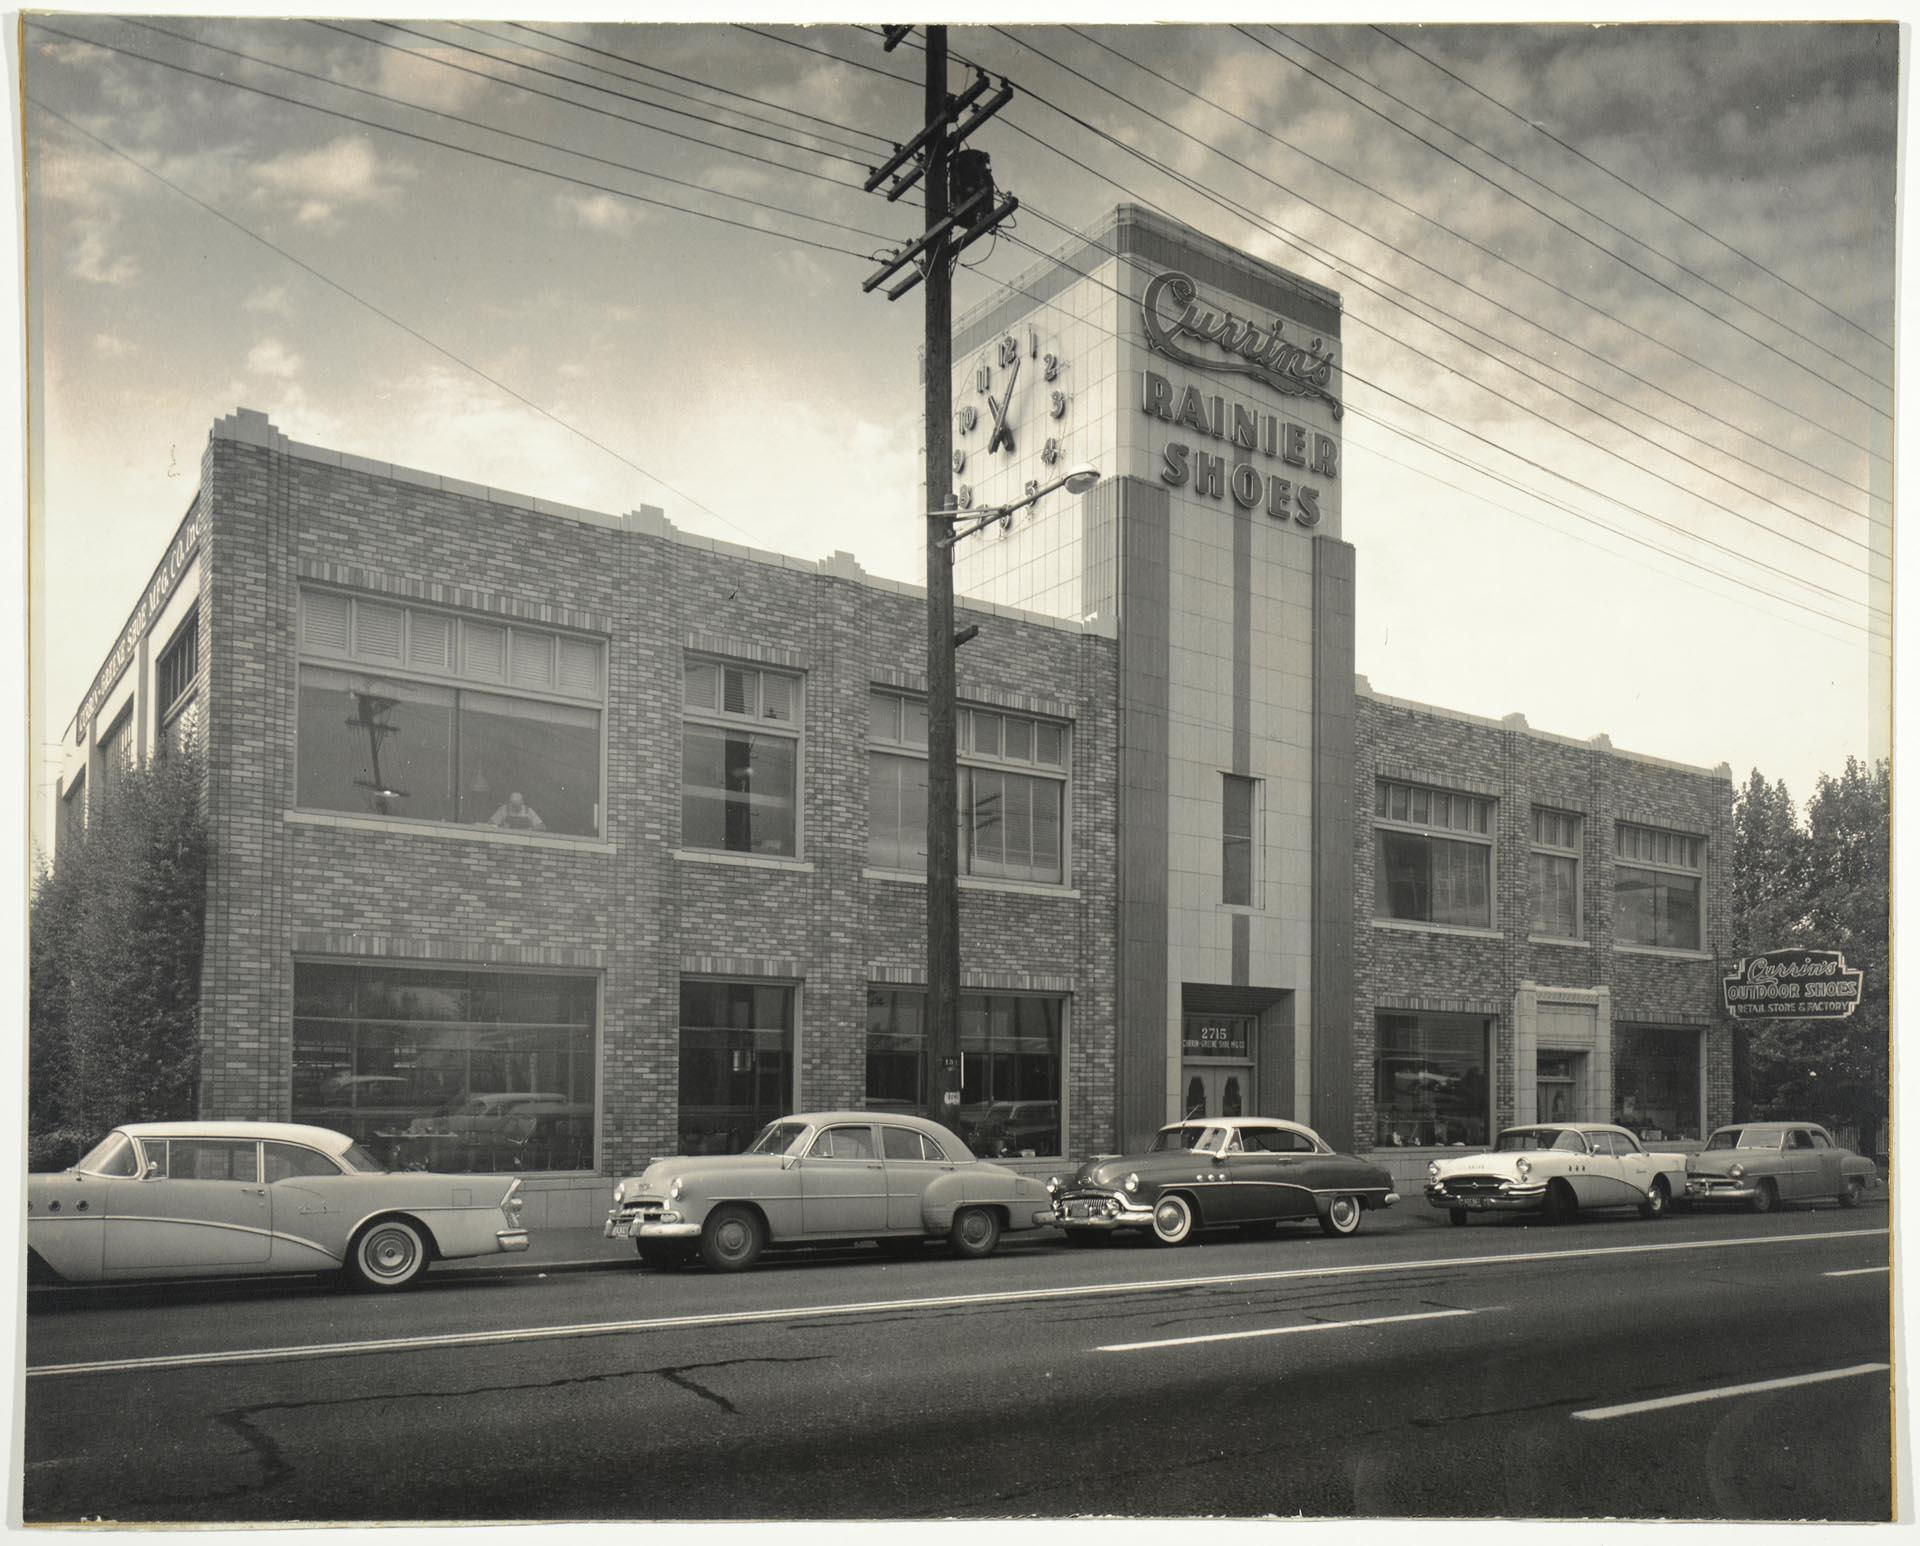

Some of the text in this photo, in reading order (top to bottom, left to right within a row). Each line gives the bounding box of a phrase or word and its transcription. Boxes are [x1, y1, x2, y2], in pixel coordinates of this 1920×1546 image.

[999, 336, 1017, 368] 12
[1029, 332, 1037, 360] 1
[1142, 271, 1343, 421] Currin's
[977, 365, 990, 394] 11
[1044, 353, 1058, 382] 2
[1050, 390, 1065, 419] 3
[959, 405, 977, 436] 10
[1143, 370, 1339, 478] RAINIER
[953, 449, 965, 474] 9
[1025, 480, 1038, 507] 5
[1162, 440, 1321, 526] SHOES
[127, 603, 146, 652] SHOE
[1747, 957, 1838, 985] Currin's
[1728, 980, 1858, 1000] OUTDOOR SHOES
[1737, 1004, 1766, 1013] RETAIL
[1768, 1003, 1797, 1013] STORE
[1807, 1001, 1848, 1013] FACTORY
[1201, 1027, 1227, 1039] 2715
